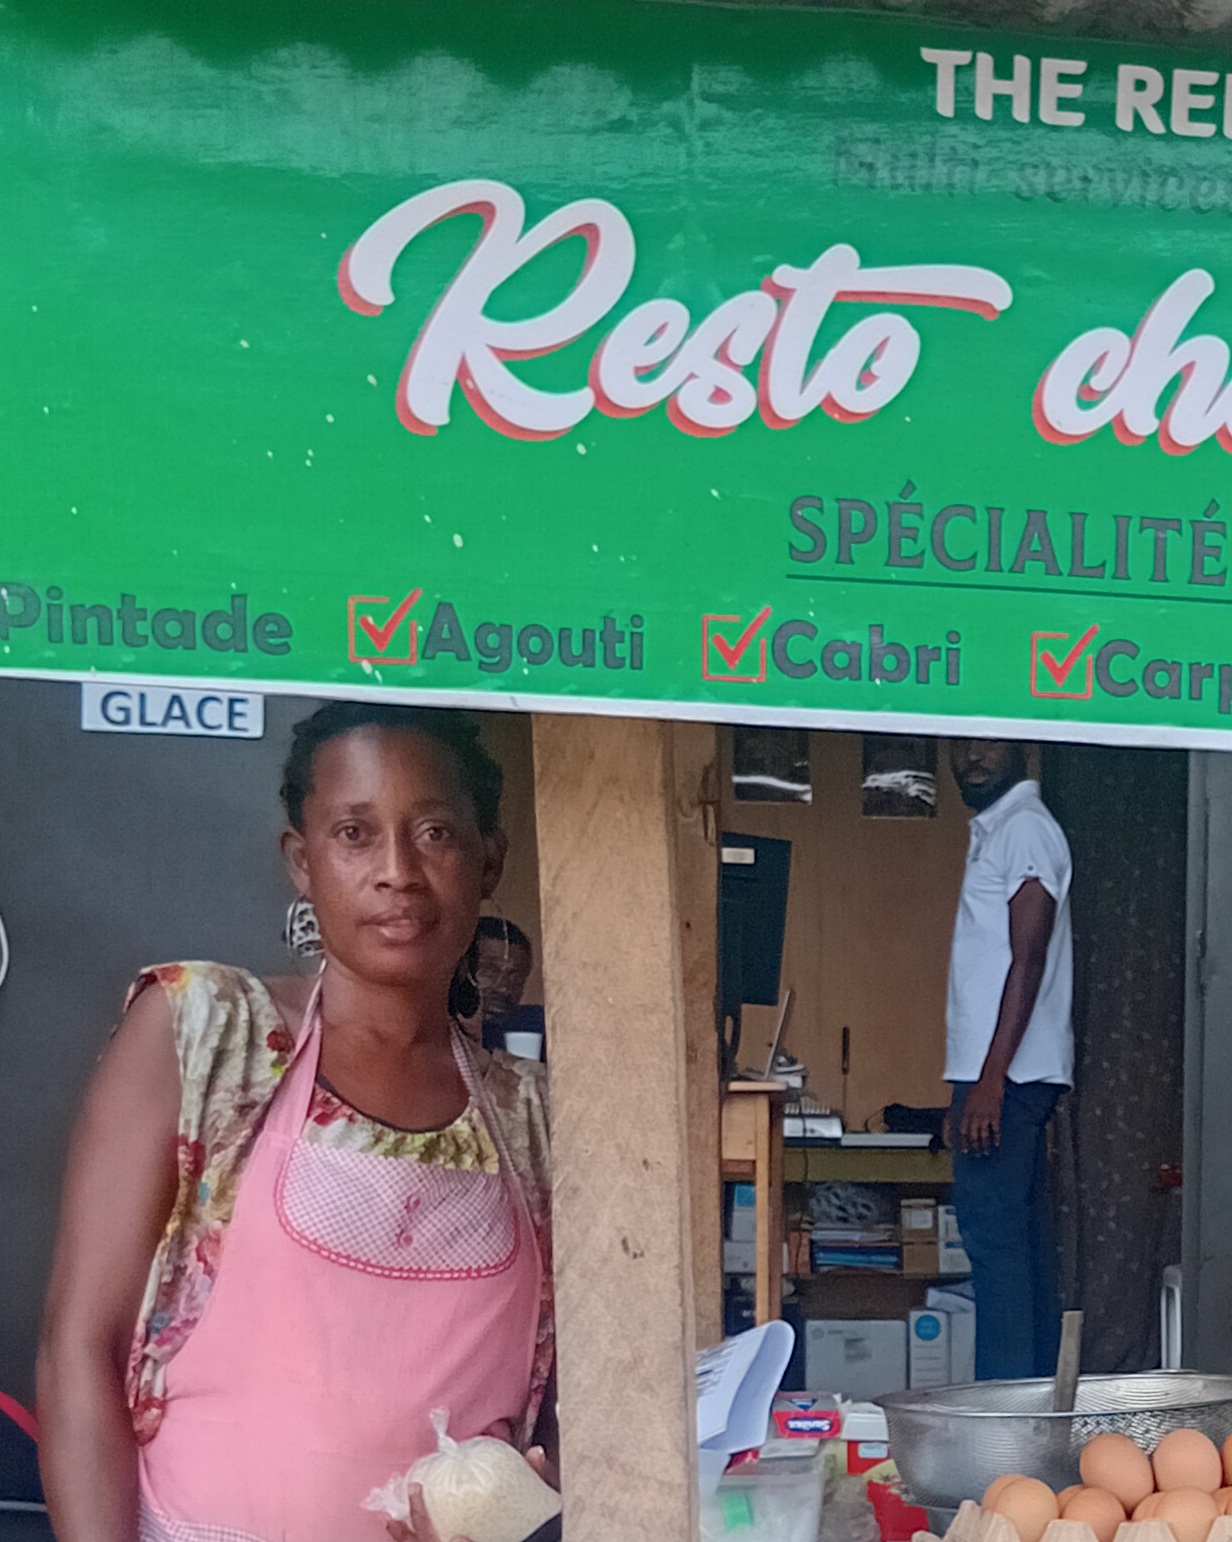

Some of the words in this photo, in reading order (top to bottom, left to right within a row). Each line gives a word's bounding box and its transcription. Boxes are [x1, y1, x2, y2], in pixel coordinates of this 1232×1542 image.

[920, 47, 1088, 127] THE
[337, 178, 1013, 442] Resto
[787, 479, 1228, 587] SPÉCIALITÉ
[0, 581, 294, 656] Pintade
[421, 600, 646, 673] Agouti
[771, 619, 963, 687] Cabri
[100, 689, 252, 735] GLACE
